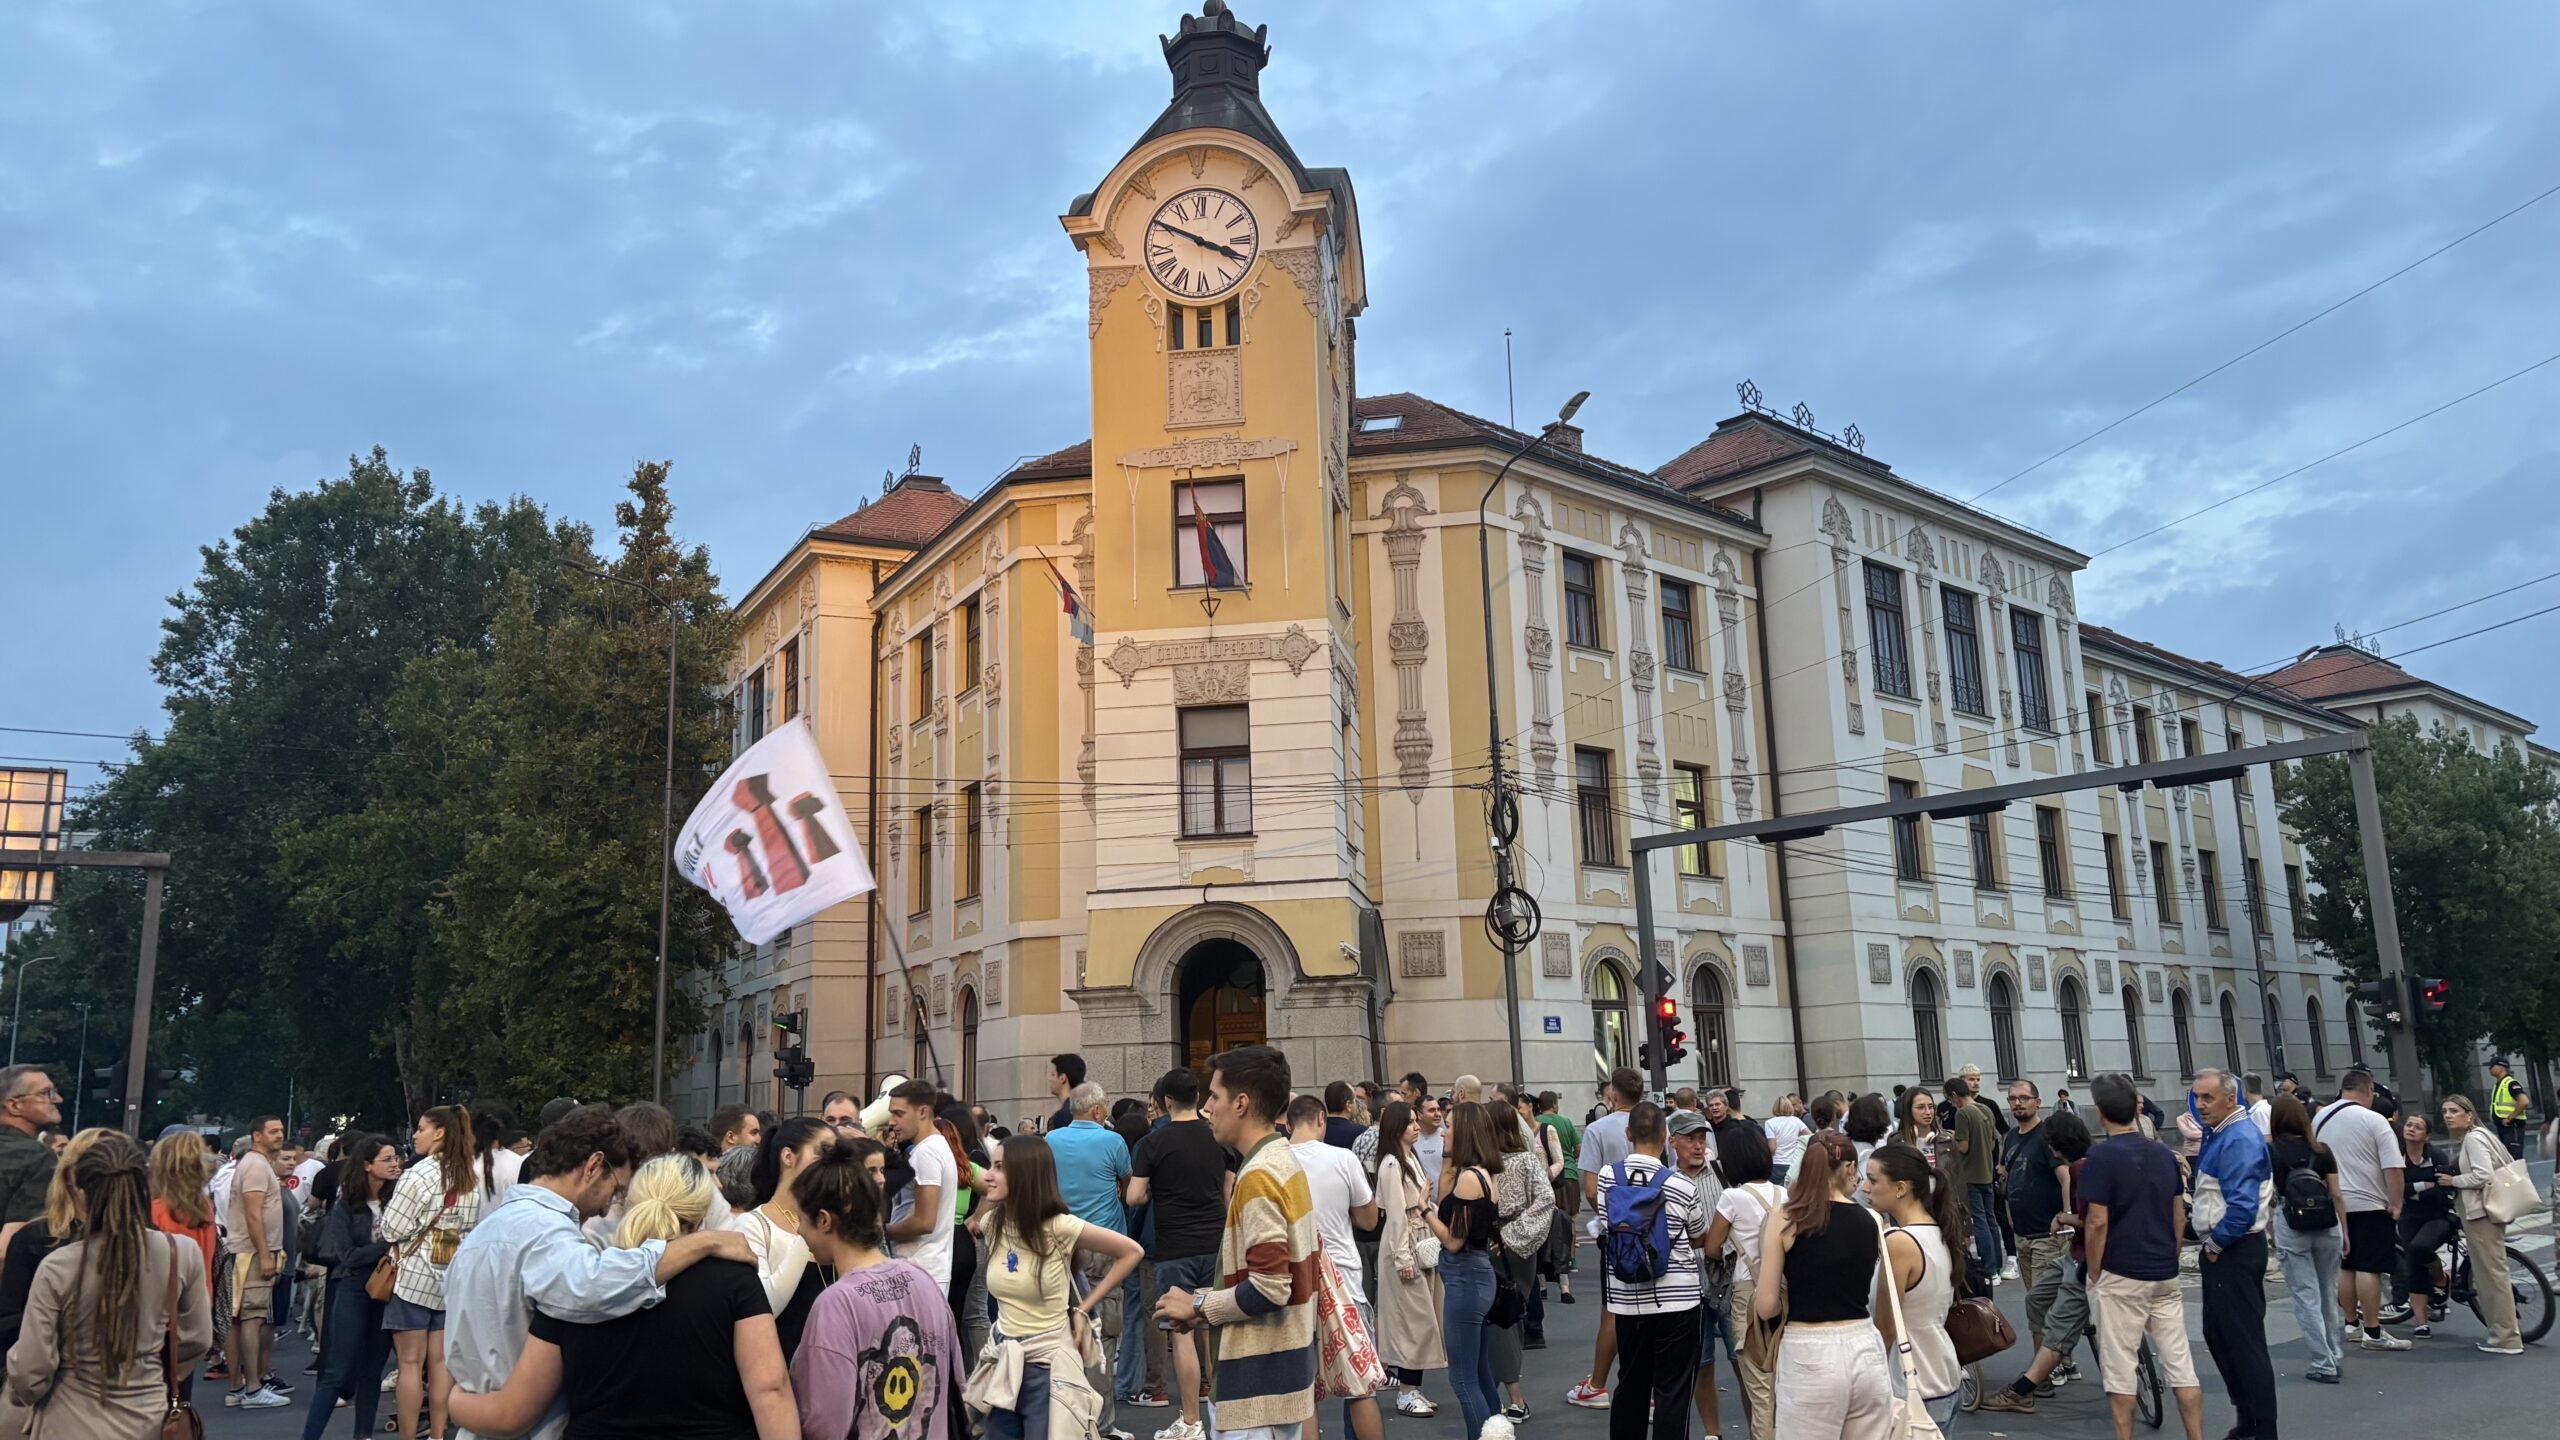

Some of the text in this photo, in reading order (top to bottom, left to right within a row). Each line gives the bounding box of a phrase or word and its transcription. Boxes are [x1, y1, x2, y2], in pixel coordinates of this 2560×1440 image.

[1168, 203, 1189, 224] XI
[1191, 196, 1207, 218] XII
[1225, 213, 1245, 229] II
[1152, 243, 1174, 256] IX
[1229, 234, 1251, 245] III
[1156, 256, 1178, 278] VIII
[1217, 266, 1232, 286] V
[1172, 267, 1189, 290] VII
[1196, 271, 1210, 292] VI
